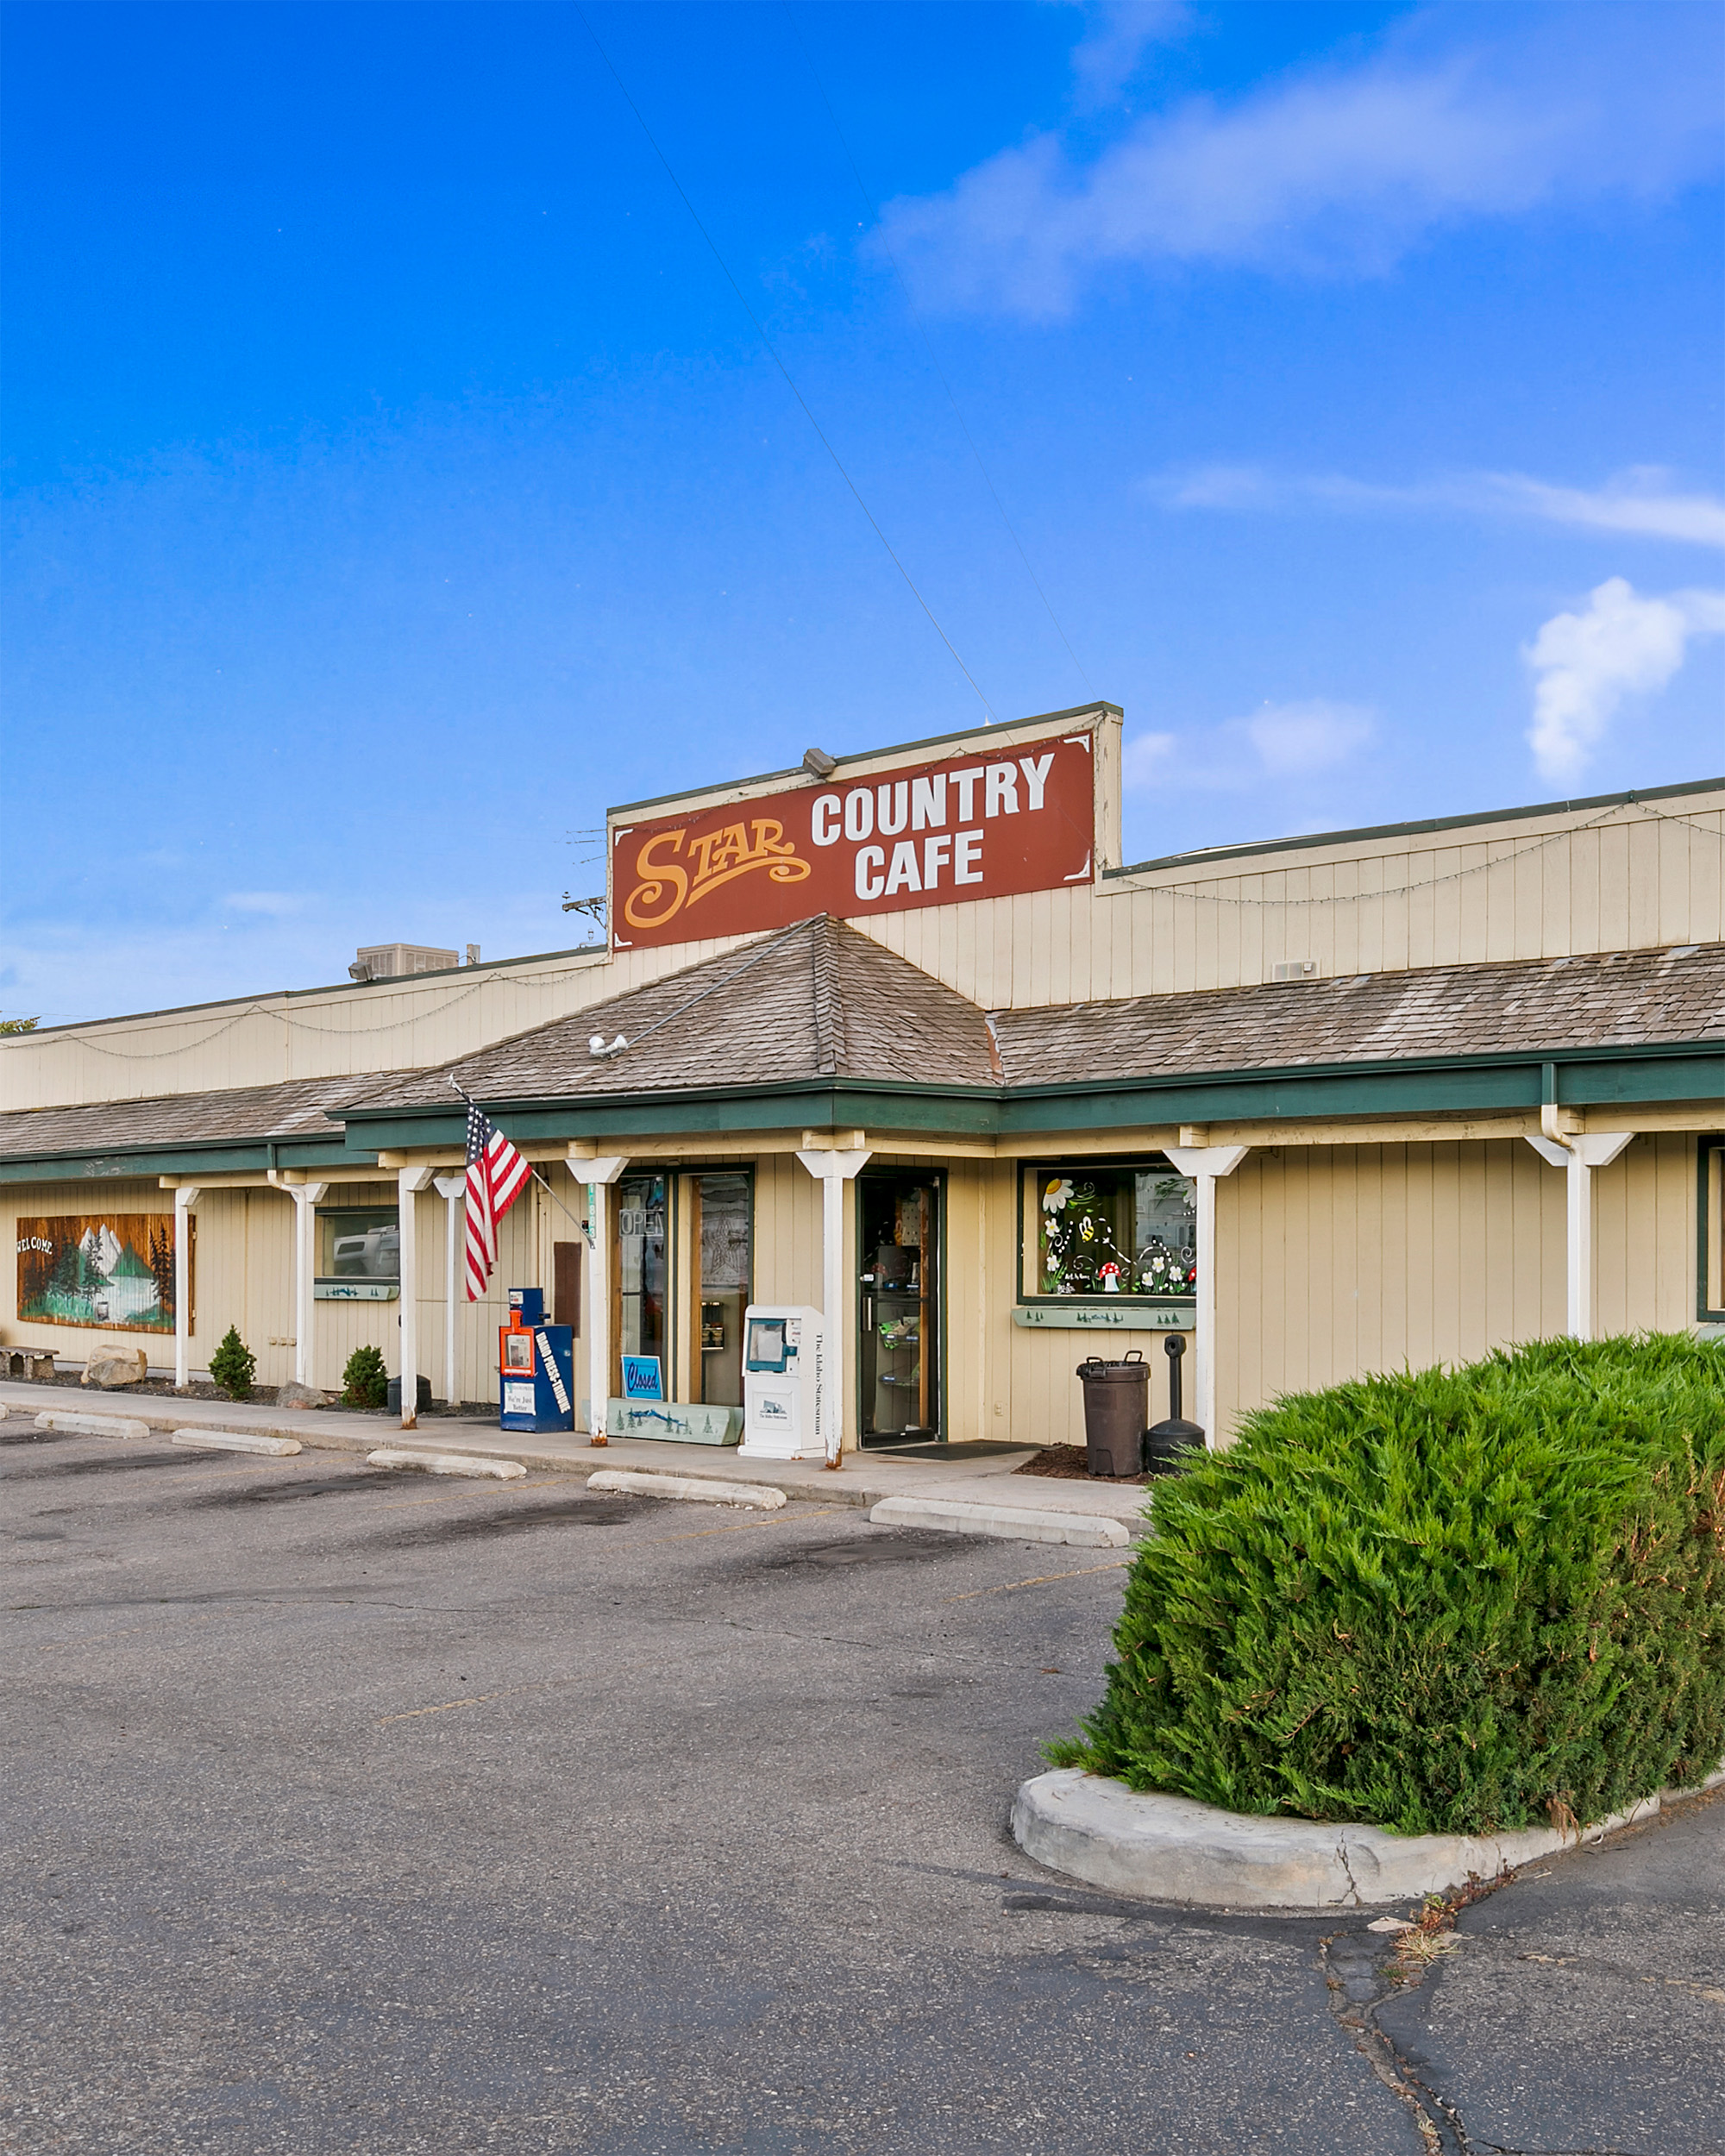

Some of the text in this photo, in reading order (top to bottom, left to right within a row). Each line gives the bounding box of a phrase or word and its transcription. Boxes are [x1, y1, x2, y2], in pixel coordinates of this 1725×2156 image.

[811, 752, 1056, 847] COUNTRY
[624, 818, 812, 929] STAR
[855, 829, 984, 901] CAFE
[536, 1332, 552, 1358] IDAHO
[627, 1362, 658, 1392] Closed
[814, 1332, 824, 1436] The Idaho Statesman
